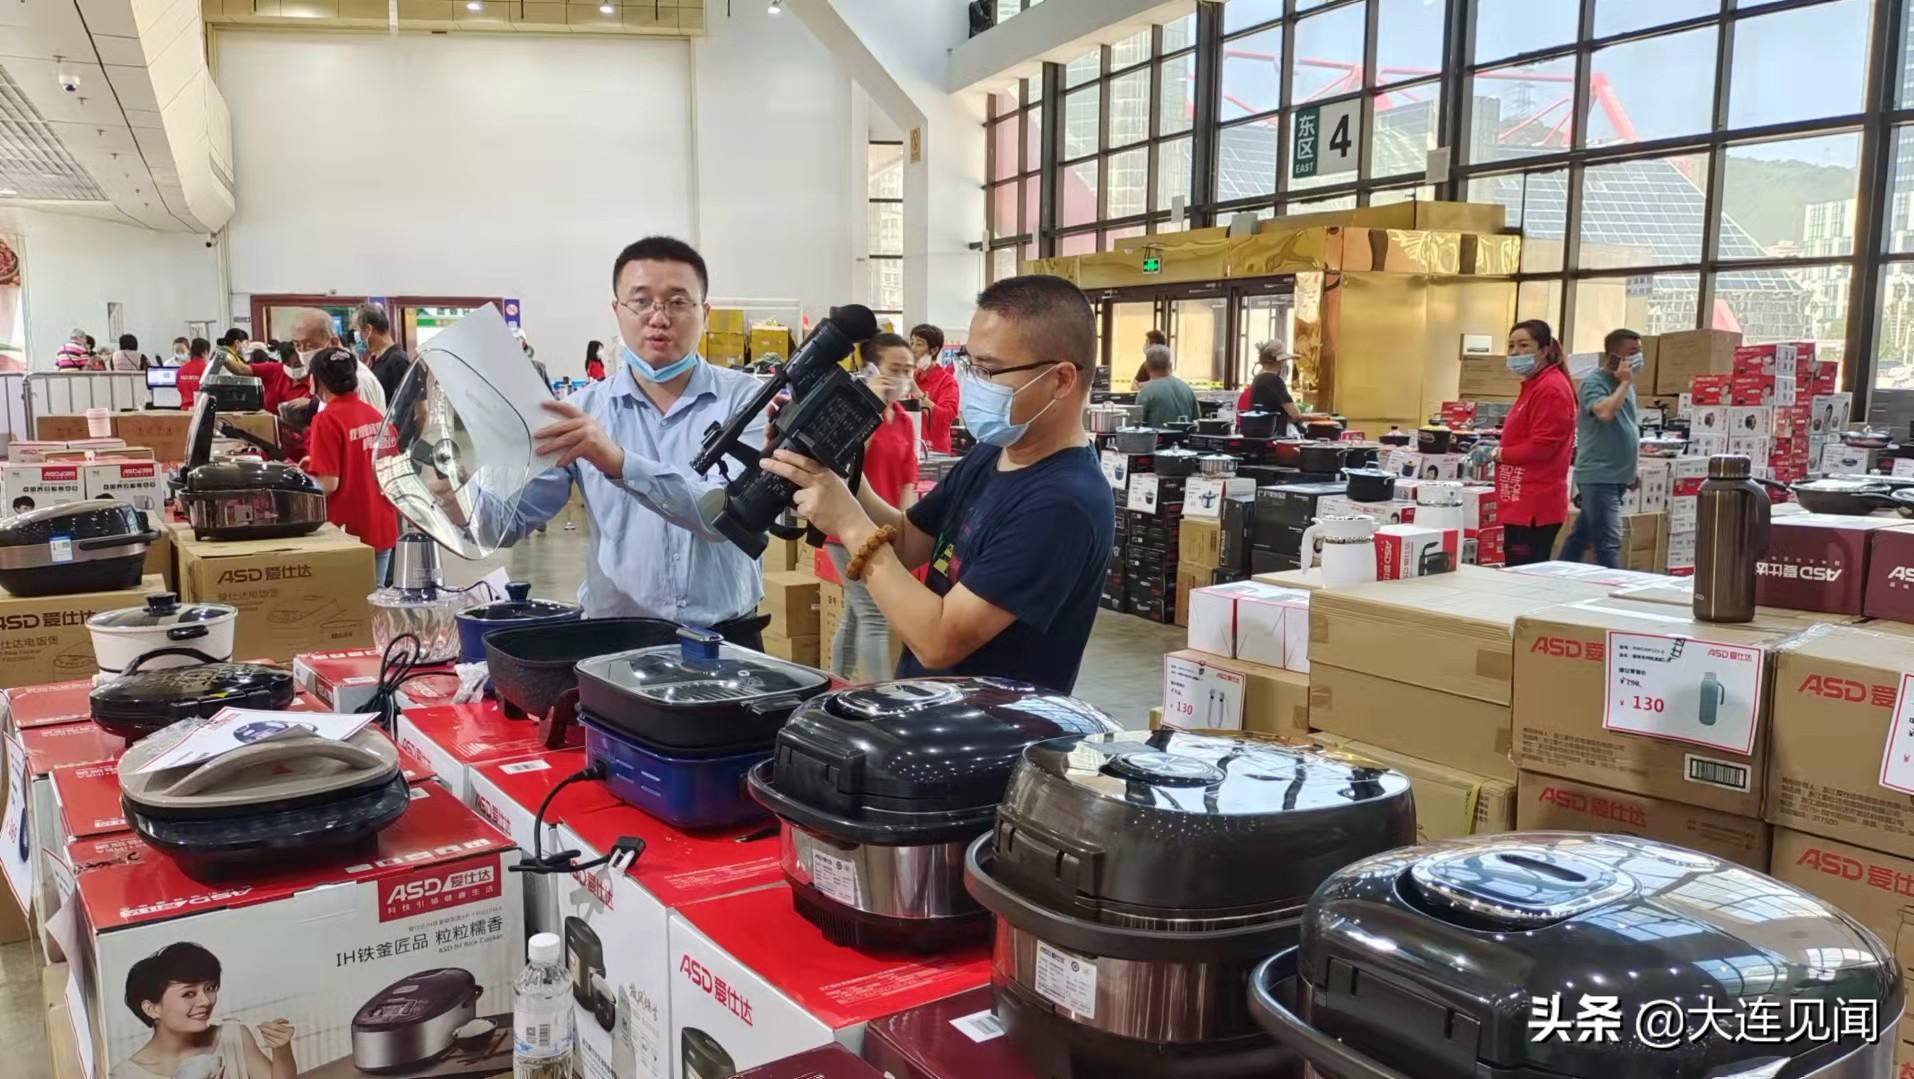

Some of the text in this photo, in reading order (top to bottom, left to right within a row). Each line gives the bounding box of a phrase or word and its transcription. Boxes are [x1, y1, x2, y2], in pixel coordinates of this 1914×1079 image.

[1297, 114, 1316, 160] 东区
[1329, 113, 1352, 158] 4
[1295, 162, 1314, 174] EAST
[217, 563, 313, 585] ASD 爱仕达
[1755, 560, 1797, 579] 爱仕达
[1799, 566, 1843, 582] ASD
[1530, 635, 1582, 658] ASD
[1707, 648, 1752, 663] ASD 爱仕达
[1797, 674, 1867, 702] ASD
[1176, 701, 1193, 716] 130
[1632, 695, 1665, 713] 130
[1538, 785, 1647, 828] ASD 爱仕达
[1796, 847, 1864, 881] ASD
[386, 869, 492, 905] ASD 爱仕达
[336, 933, 429, 967] IH铁釜匠品
[435, 915, 503, 944] 粒粒糯香
[438, 944, 453, 953] ASD
[679, 954, 753, 1027] ASD 爱仕达
